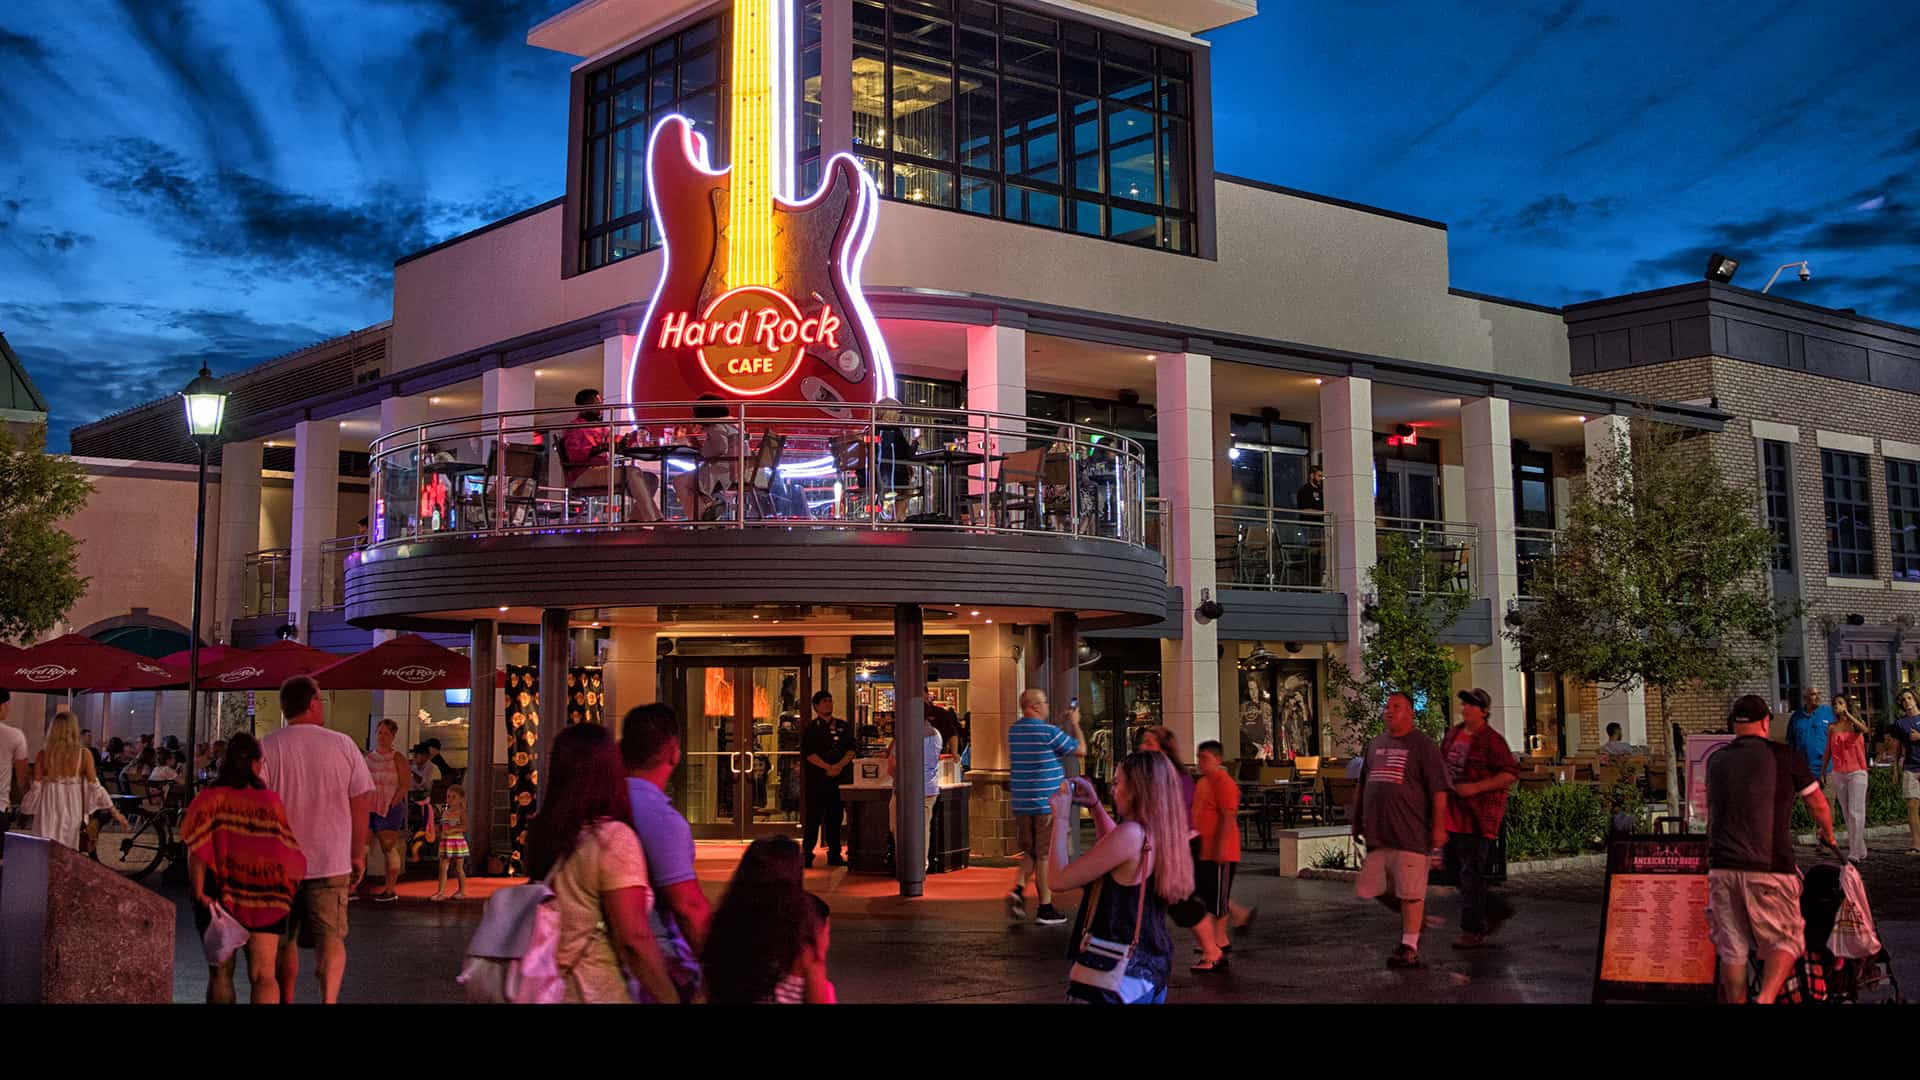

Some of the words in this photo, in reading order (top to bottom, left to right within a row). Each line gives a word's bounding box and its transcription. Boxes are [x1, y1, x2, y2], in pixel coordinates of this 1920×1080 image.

[659, 310, 748, 350] Hard
[754, 304, 841, 352] Rock
[727, 357, 774, 375] CAFE
[382, 668, 416, 677] Hard
[416, 668, 447, 678] Rock
[1633, 857, 1666, 865] AMERICAN
[1667, 856, 1680, 865] TAP
